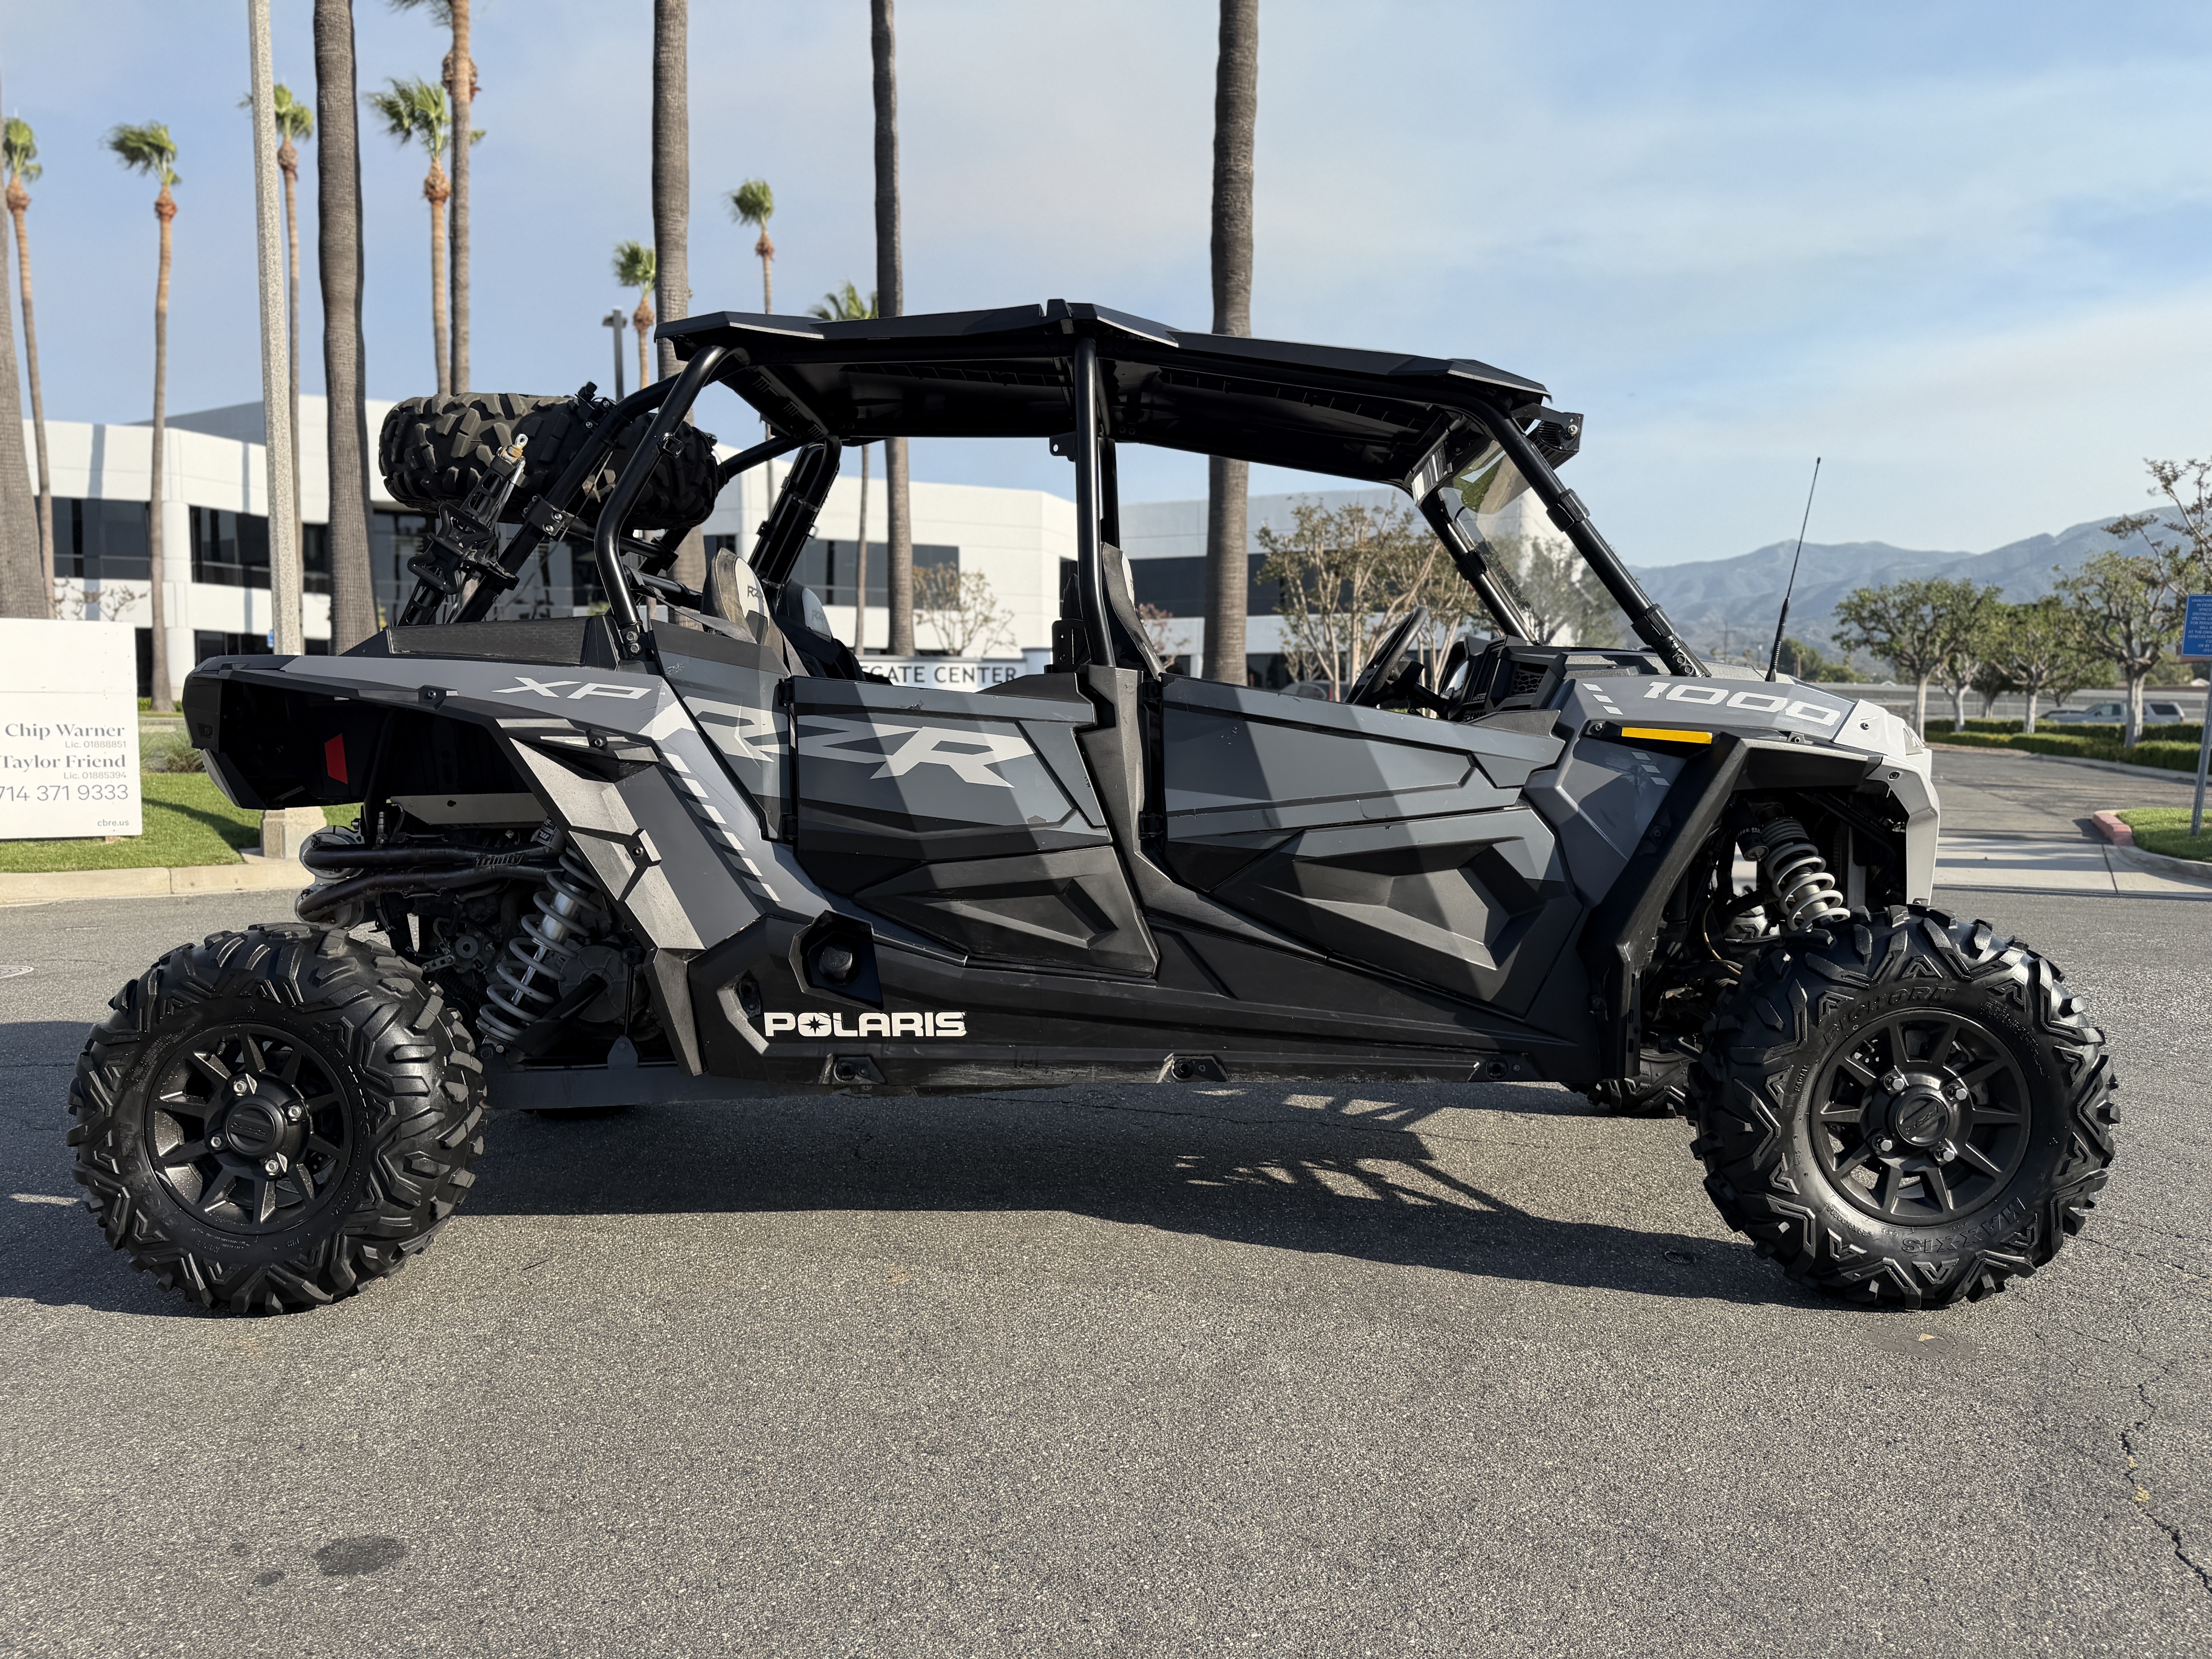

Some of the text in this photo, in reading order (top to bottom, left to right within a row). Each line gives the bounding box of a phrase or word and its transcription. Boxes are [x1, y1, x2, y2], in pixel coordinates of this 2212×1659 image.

[934, 666, 1017, 684] CENTER
[491, 677, 652, 699] XP
[1644, 681, 1841, 726] 1000
[5, 723, 125, 740] Chip Warner
[637, 696, 1037, 788] RZR
[0, 754, 125, 772] Taylor Friend
[37, 785, 69, 801] 371
[77, 784, 128, 800] 9333
[97, 819, 129, 827] cbre.us
[764, 1012, 967, 1037] POLARIS
[1901, 1197, 2027, 1254] MAXXIS
